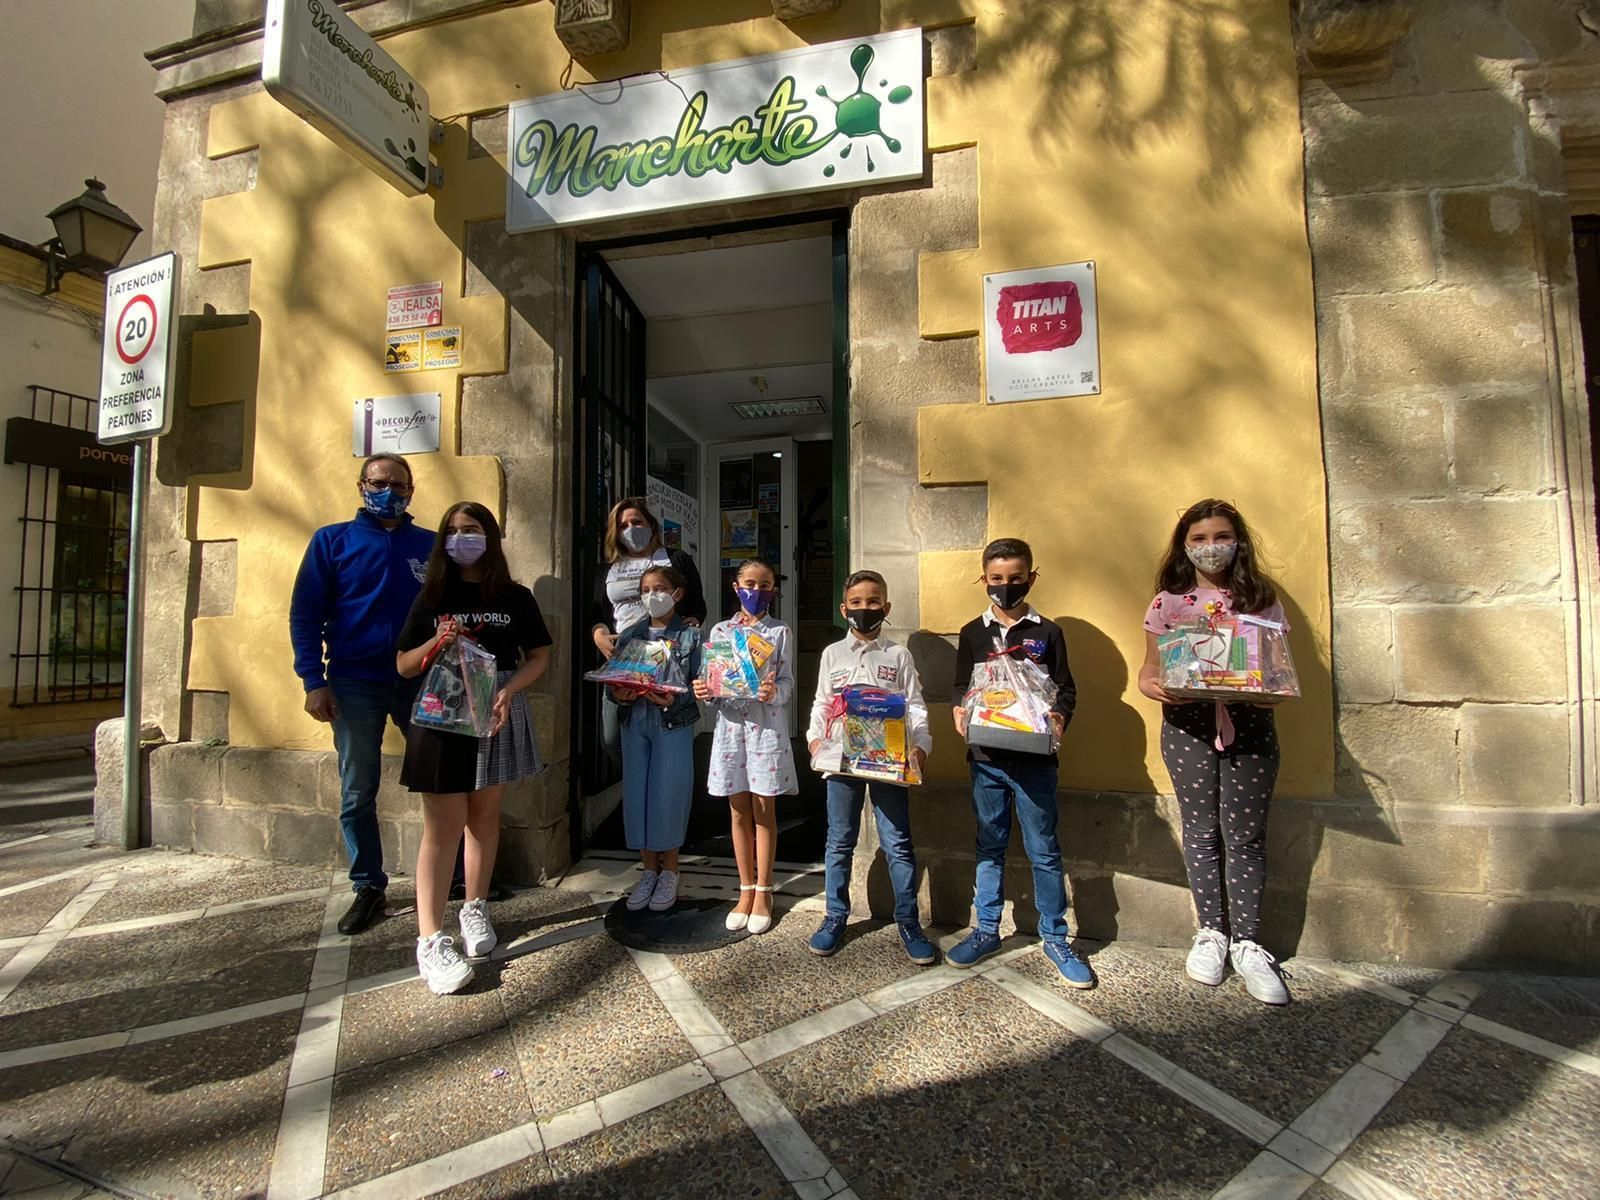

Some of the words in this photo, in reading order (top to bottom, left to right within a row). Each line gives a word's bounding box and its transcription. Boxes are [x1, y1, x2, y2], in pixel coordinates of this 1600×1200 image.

[308, 0, 402, 103] Mancharte
[516, 75, 822, 199] Mancharte
[400, 296, 440, 313] JEALSA
[1012, 296, 1067, 320] TITAN
[124, 317, 147, 342] 20
[425, 327, 460, 338] CONECTADA
[1013, 320, 1068, 335] ARTS
[387, 332, 421, 344] CONECTADA
[385, 362, 419, 371] PROSEGUR
[424, 358, 460, 367] PROSEGUR
[120, 369, 145, 386] ZONA
[1008, 383, 1030, 391] OCIO
[1033, 379, 1074, 388] CREATIVO
[1045, 373, 1071, 381] ARTES
[102, 386, 162, 411] PREFERENCIA
[107, 409, 153, 430] PEATONES
[471, 612, 511, 625] WORLD
